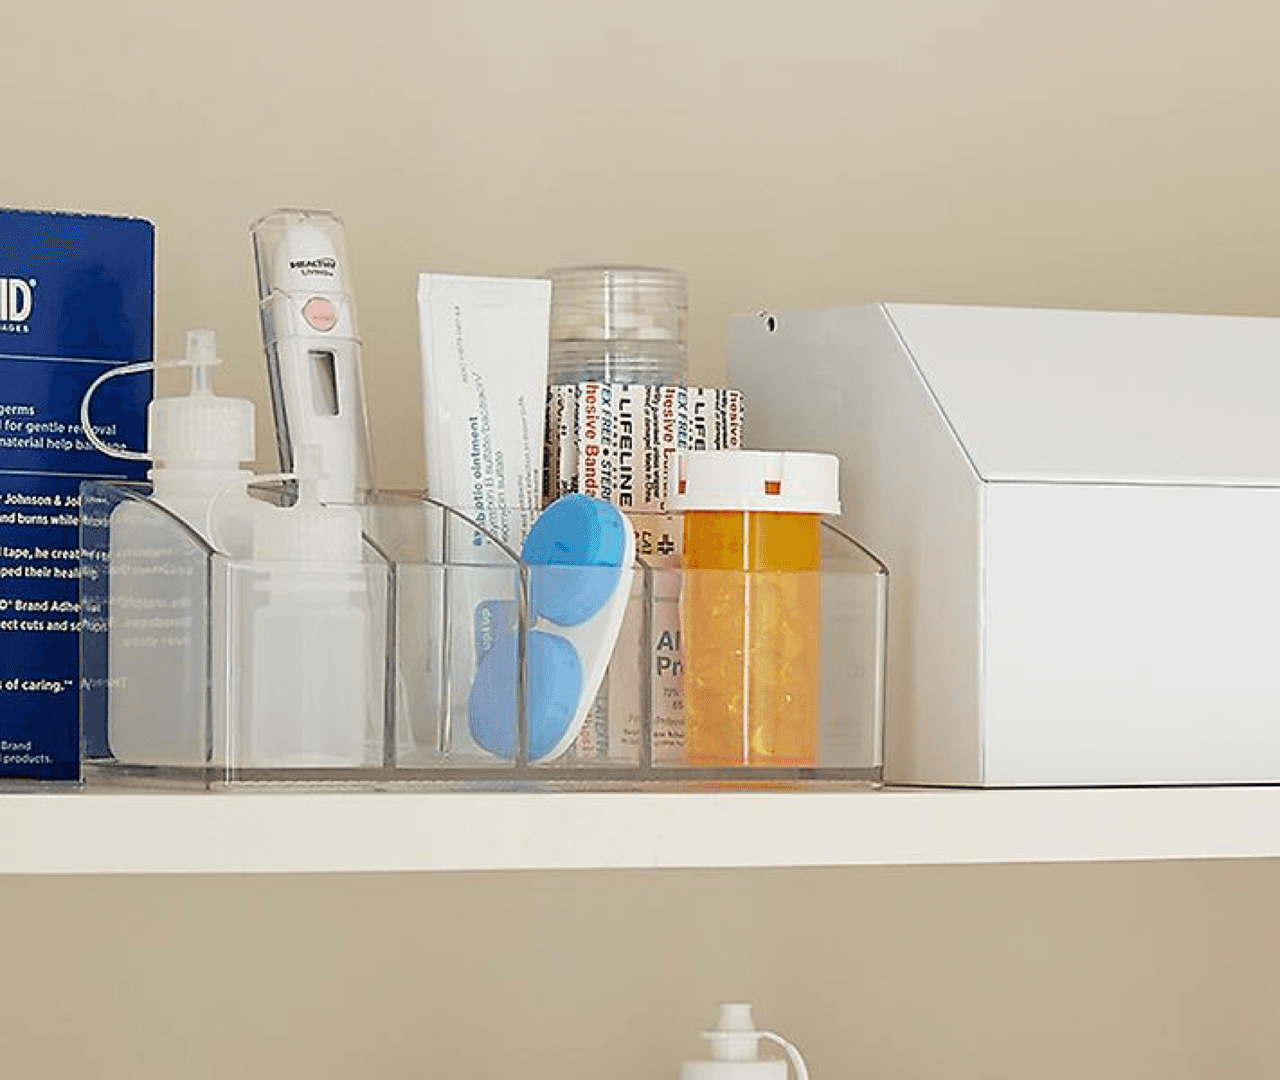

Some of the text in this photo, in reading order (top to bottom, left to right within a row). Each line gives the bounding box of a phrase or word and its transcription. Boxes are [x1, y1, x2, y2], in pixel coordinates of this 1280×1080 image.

[5, 417, 23, 431] for
[25, 420, 65, 434] gentle
[601, 410, 612, 446] FREE
[46, 437, 73, 451] help
[469, 416, 483, 479] ointment
[620, 398, 633, 507] LIFELINE
[4, 493, 52, 506] Johnson
[53, 494, 62, 506] &
[17, 513, 49, 525] burns
[50, 514, 80, 527] while
[3, 546, 33, 560] tape,
[34, 546, 49, 559] he
[24, 566, 52, 579] their
[15, 599, 49, 612] Brand
[20, 618, 44, 632] cuts
[46, 619, 68, 632] and
[5, 678, 19, 691] of
